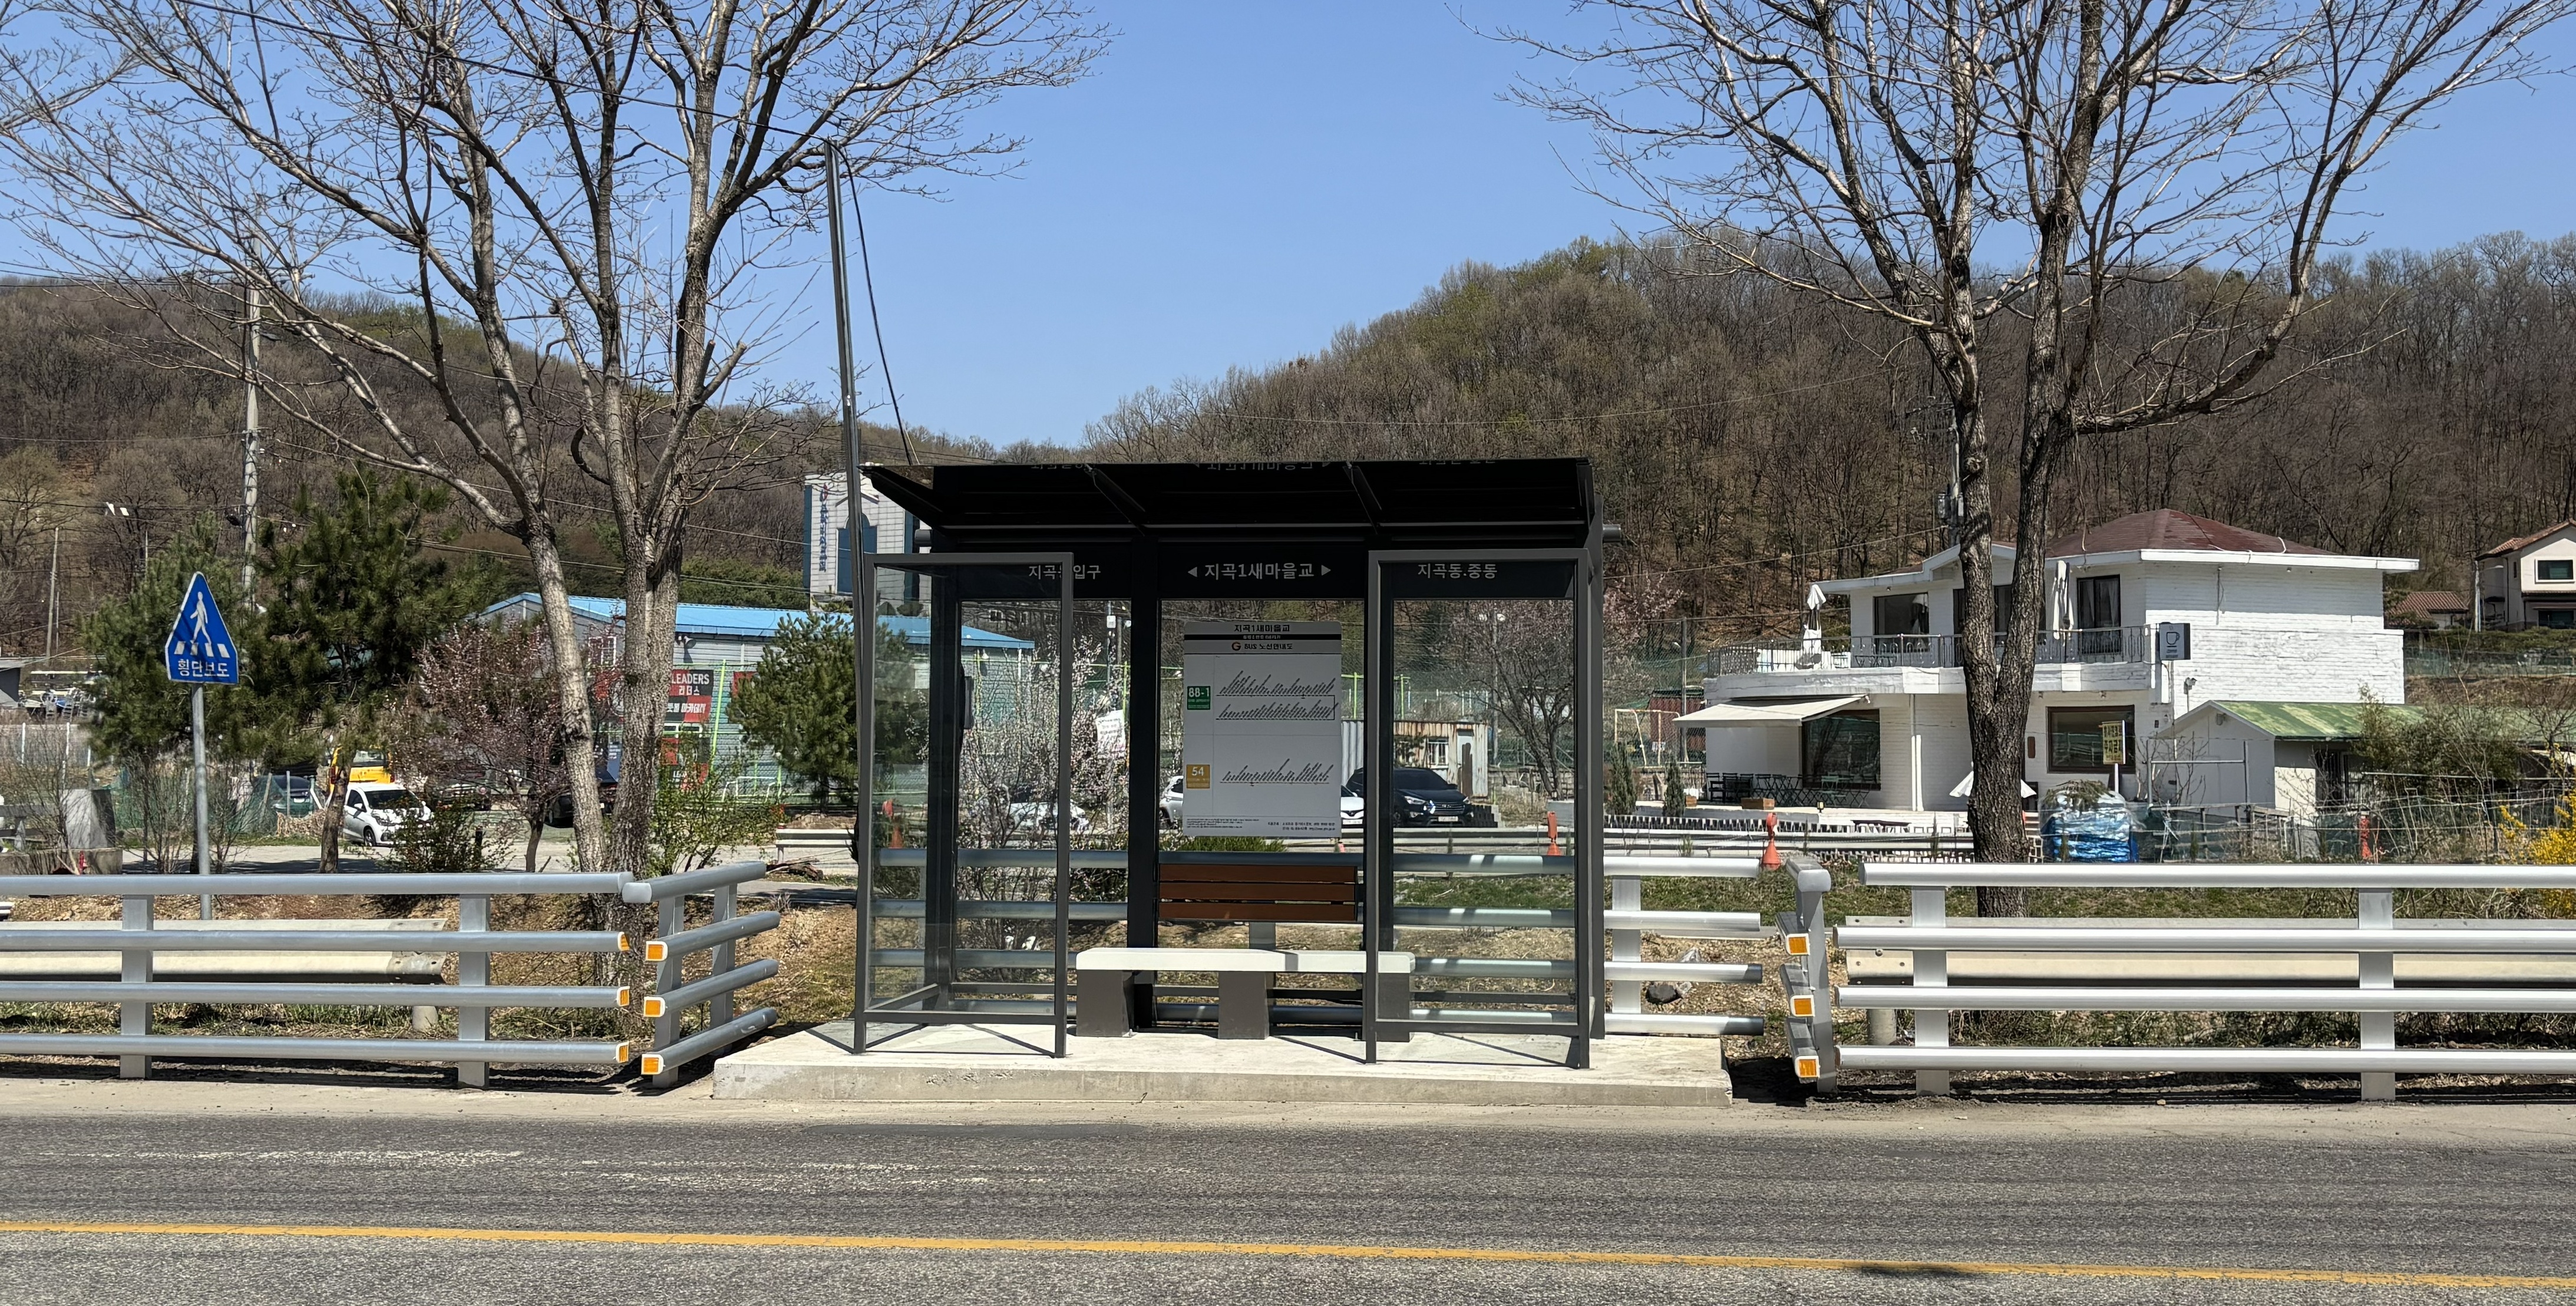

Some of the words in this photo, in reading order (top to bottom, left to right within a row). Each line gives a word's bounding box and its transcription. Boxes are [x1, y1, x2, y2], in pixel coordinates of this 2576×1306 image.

[1029, 565, 1101, 579] 지곡입구
[1205, 563, 1314, 580] 지곡1새마을교
[178, 659, 229, 677] 횡단보도
[672, 673, 710, 685] LEADERS
[679, 685, 700, 695] 리더스
[1188, 687, 1210, 697] 88-1
[1191, 767, 1204, 776] 54
